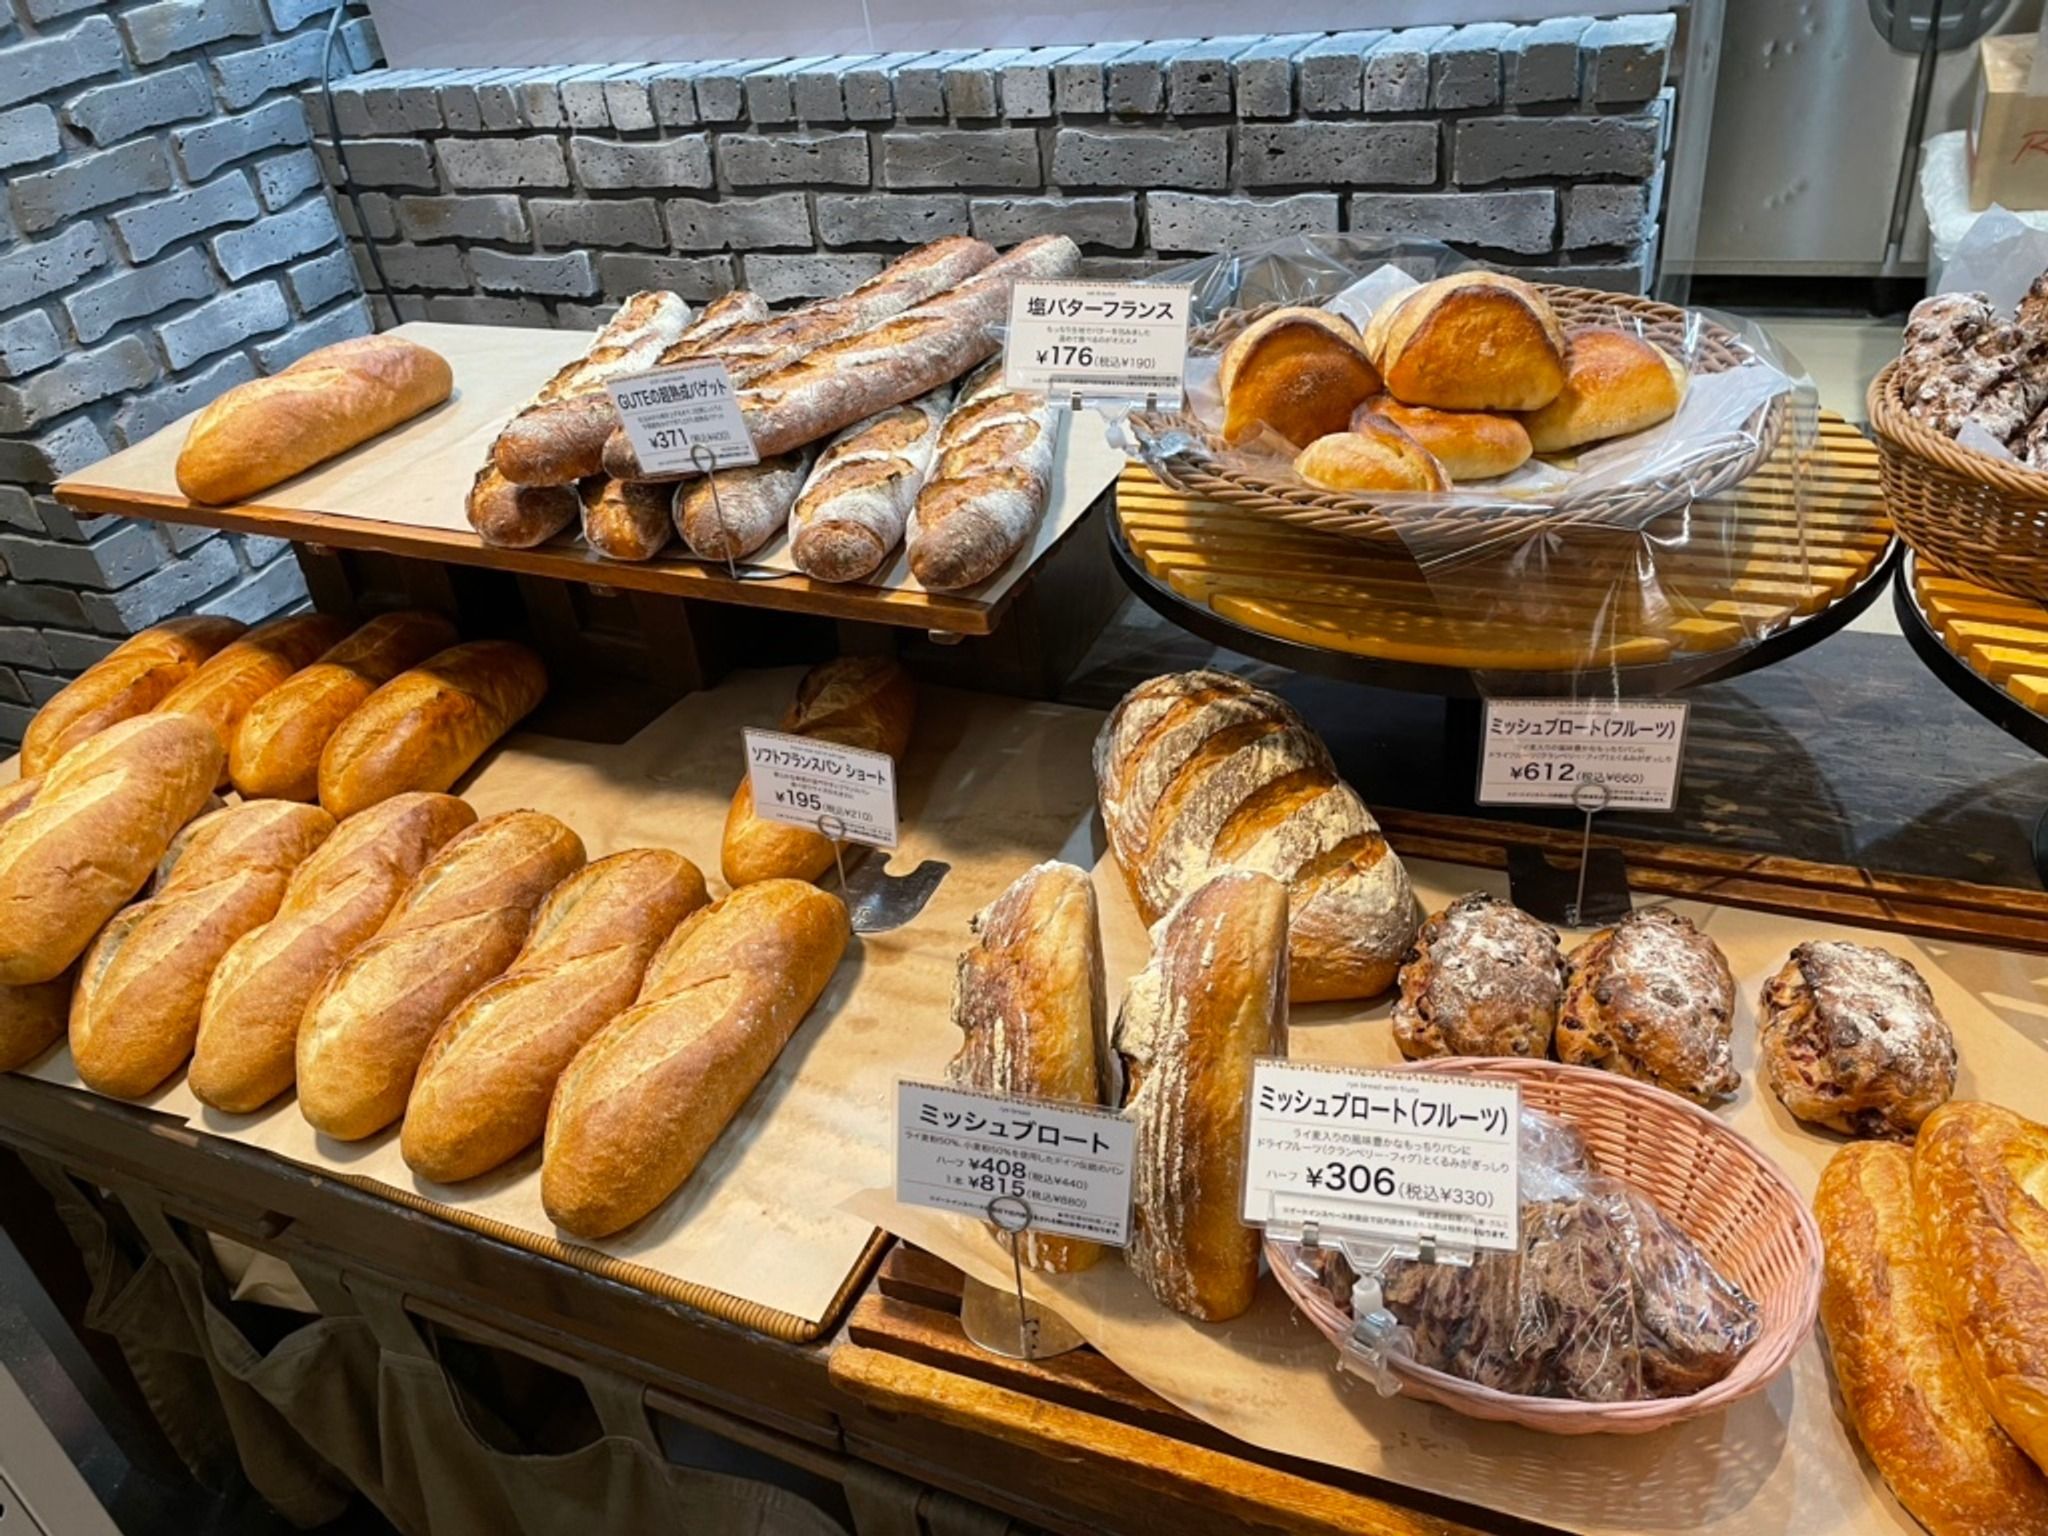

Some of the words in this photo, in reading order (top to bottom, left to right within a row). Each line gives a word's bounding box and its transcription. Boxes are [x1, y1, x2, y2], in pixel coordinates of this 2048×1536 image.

[1027, 296, 1175, 320] 塩バターフランス
[1489, 717, 1676, 740] ミッシュブロート(フルーツ)
[1258, 1084, 1510, 1137] ミッシュブロート(フルーツ)
[918, 1103, 1111, 1155] ミッシュブロート
[936, 1155, 965, 1168] ハーフ
[1266, 1169, 1299, 1183] ハーフ
